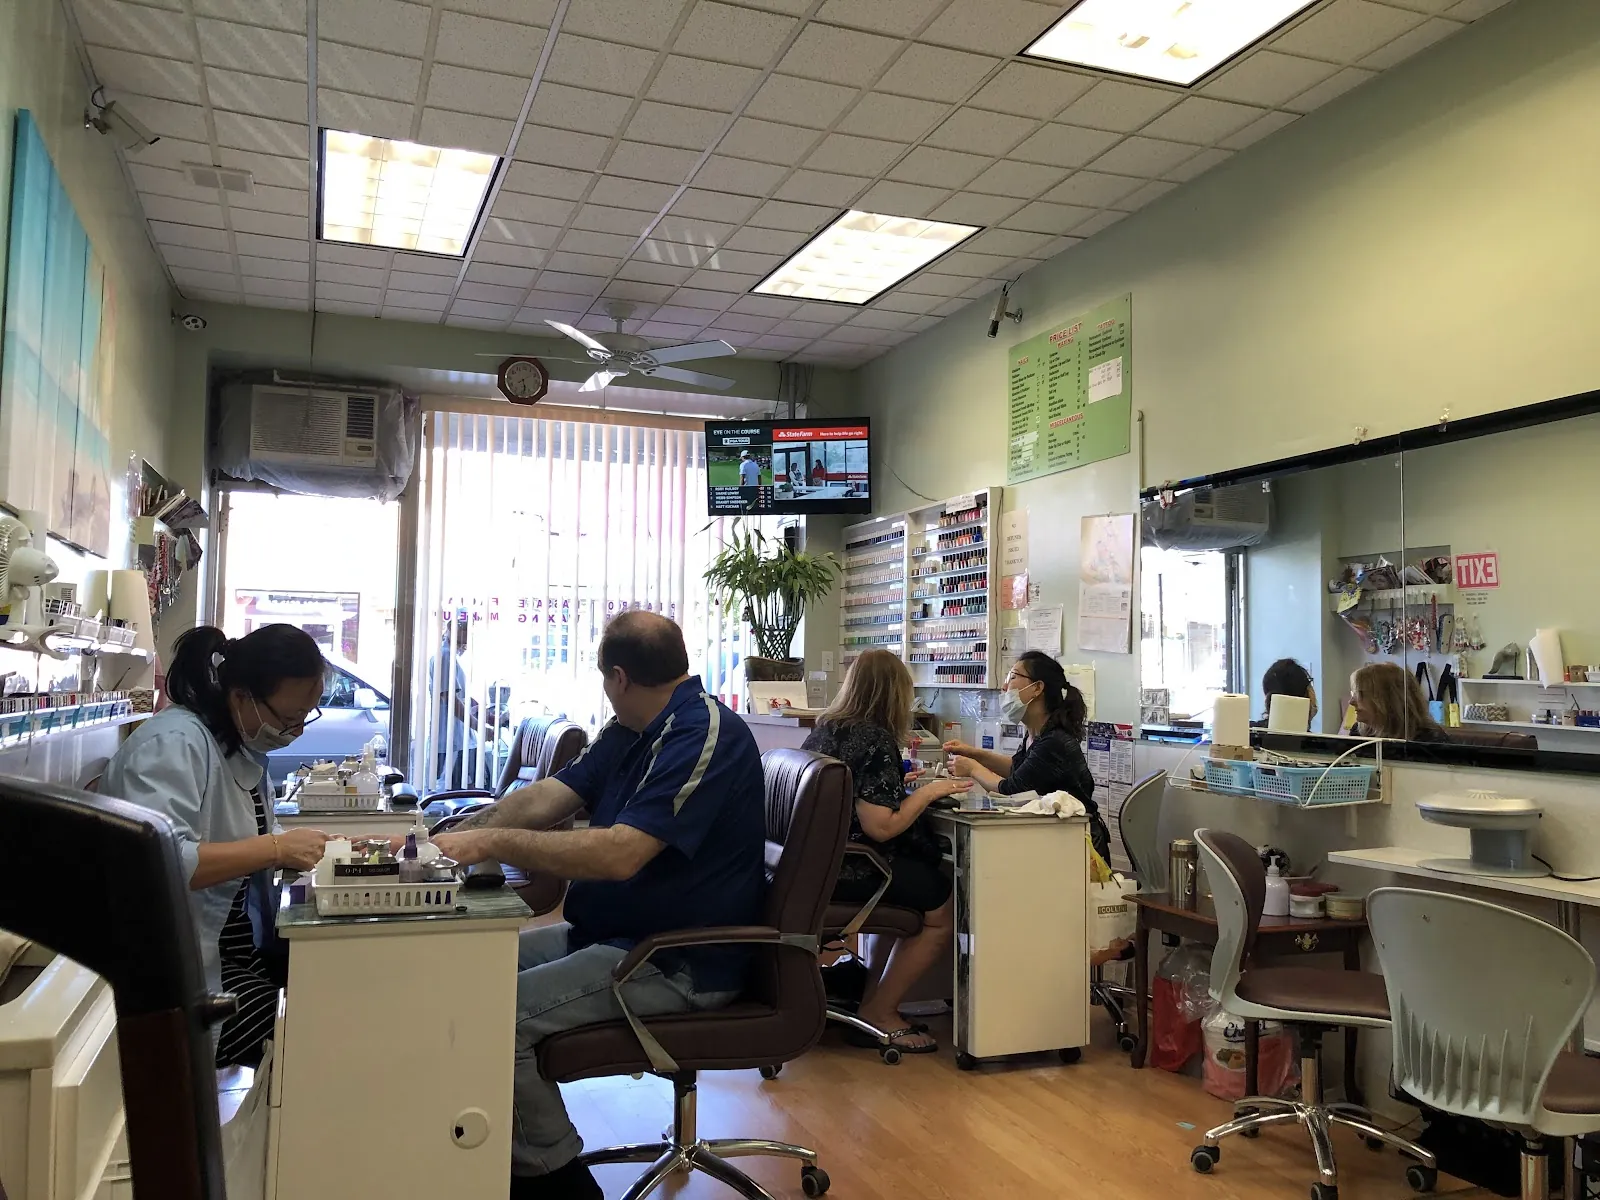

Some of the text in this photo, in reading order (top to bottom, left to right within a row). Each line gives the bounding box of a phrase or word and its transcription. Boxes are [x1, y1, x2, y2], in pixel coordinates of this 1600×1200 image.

[1049, 322, 1082, 344] PRICE LIST
[1057, 337, 1074, 348] WAXING
[1050, 412, 1084, 428] MISCELLANEOUS
